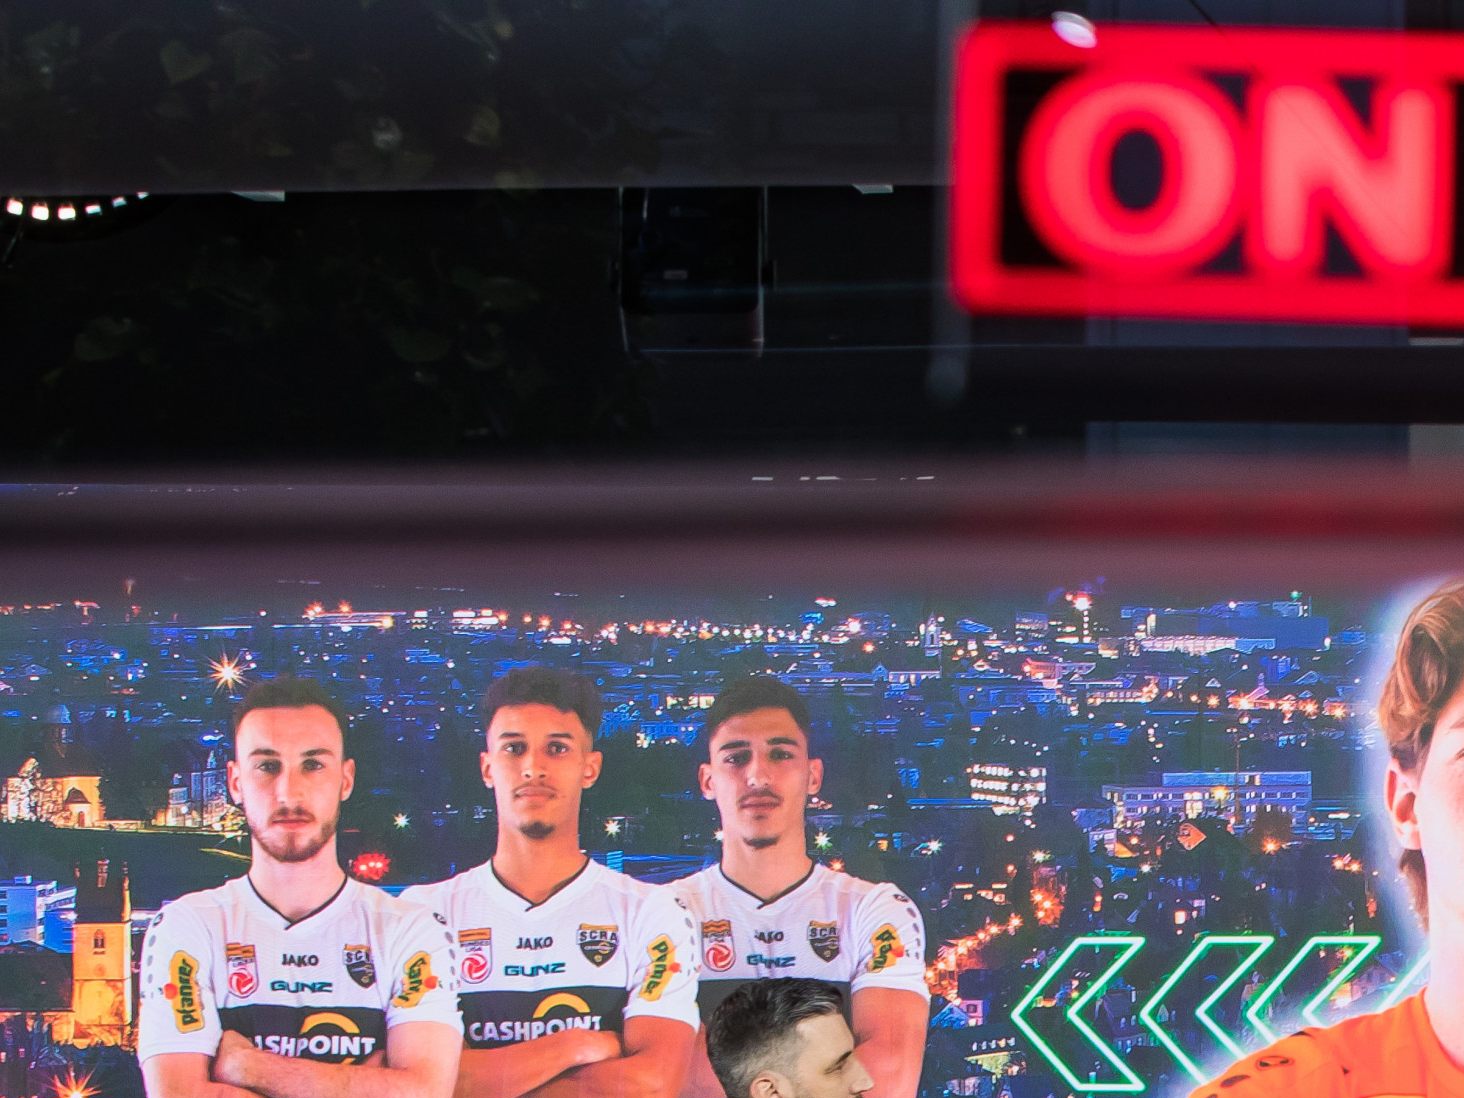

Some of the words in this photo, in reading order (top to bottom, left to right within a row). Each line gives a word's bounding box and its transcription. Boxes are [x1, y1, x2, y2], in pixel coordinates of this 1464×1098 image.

[1020, 68, 1455, 281] ON
[579, 930, 619, 941] SCRA
[516, 936, 554, 950] JAKO
[282, 953, 319, 967] JAKO
[504, 962, 566, 977] GUNZ
[271, 980, 333, 993] GUNZ
